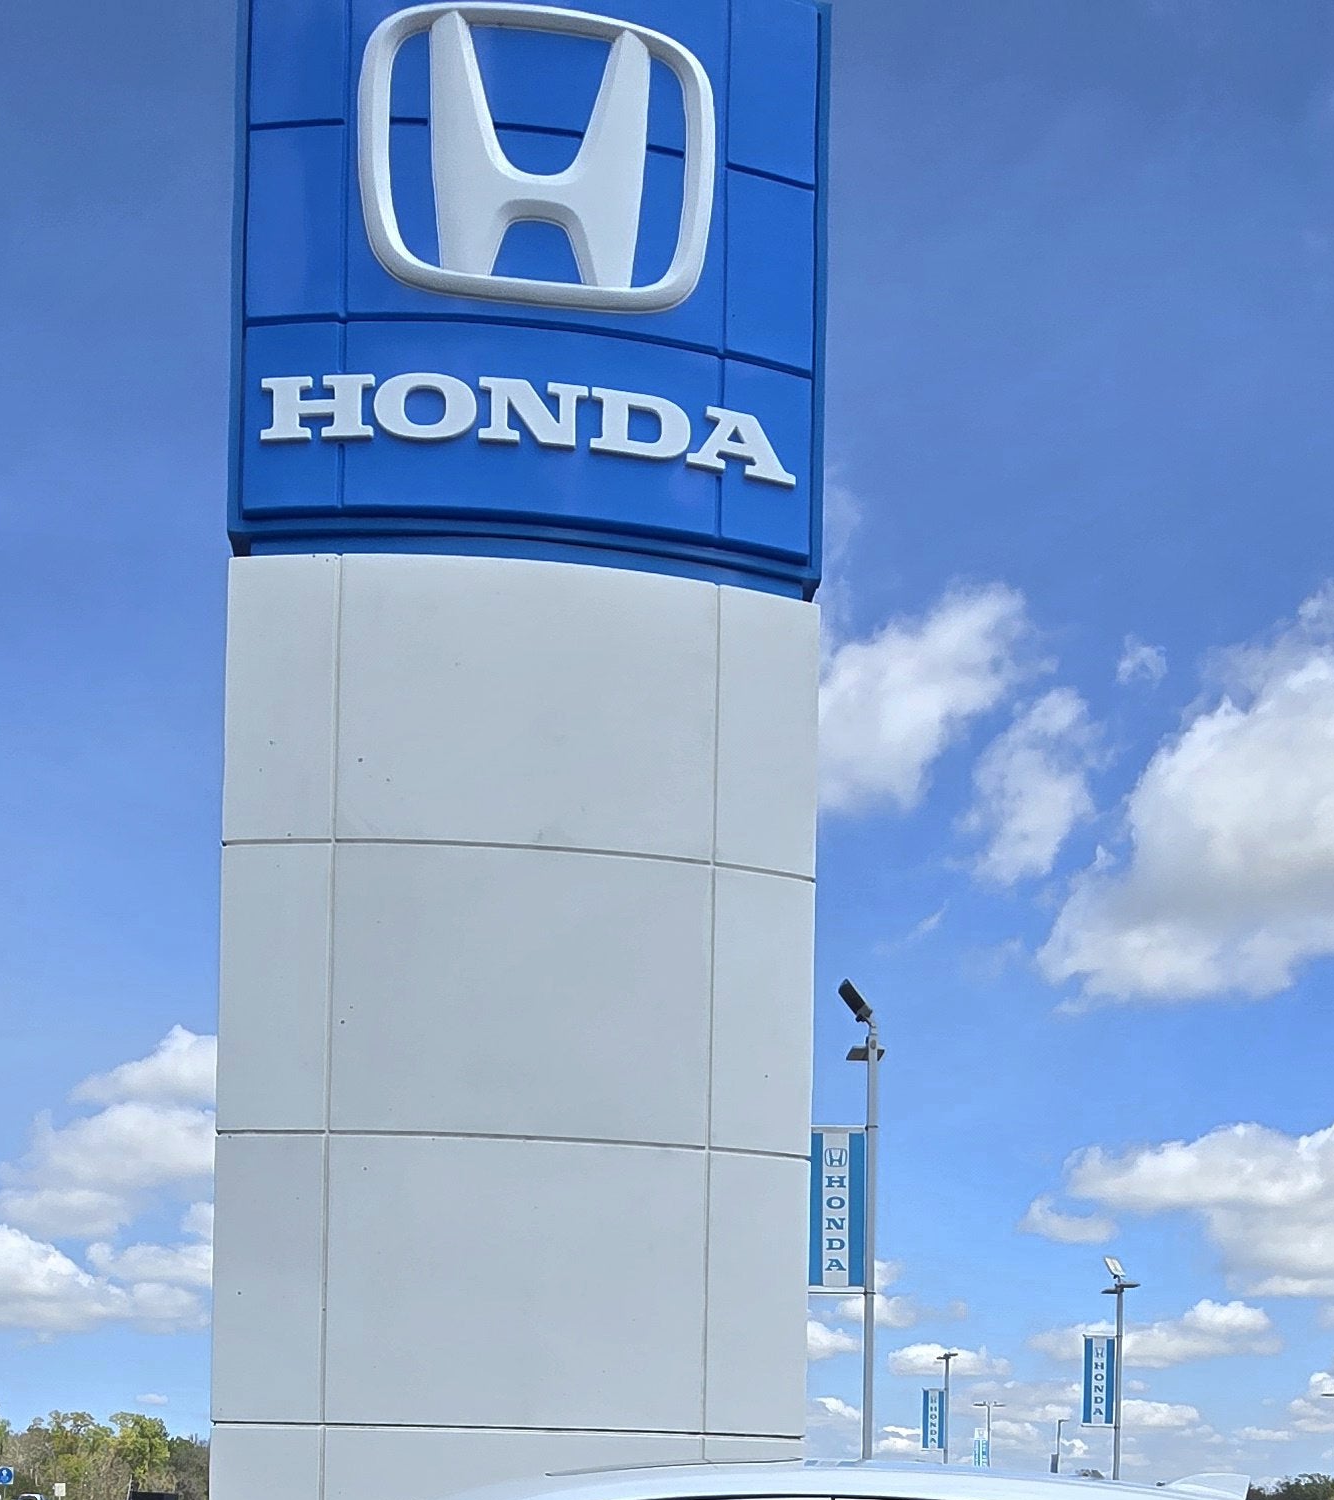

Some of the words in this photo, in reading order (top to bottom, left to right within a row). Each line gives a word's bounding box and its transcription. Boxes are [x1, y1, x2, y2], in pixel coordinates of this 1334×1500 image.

[259, 372, 797, 488] HONDA
[824, 1175, 847, 1272] HONDA
[1092, 1361, 1105, 1416] HONDA
